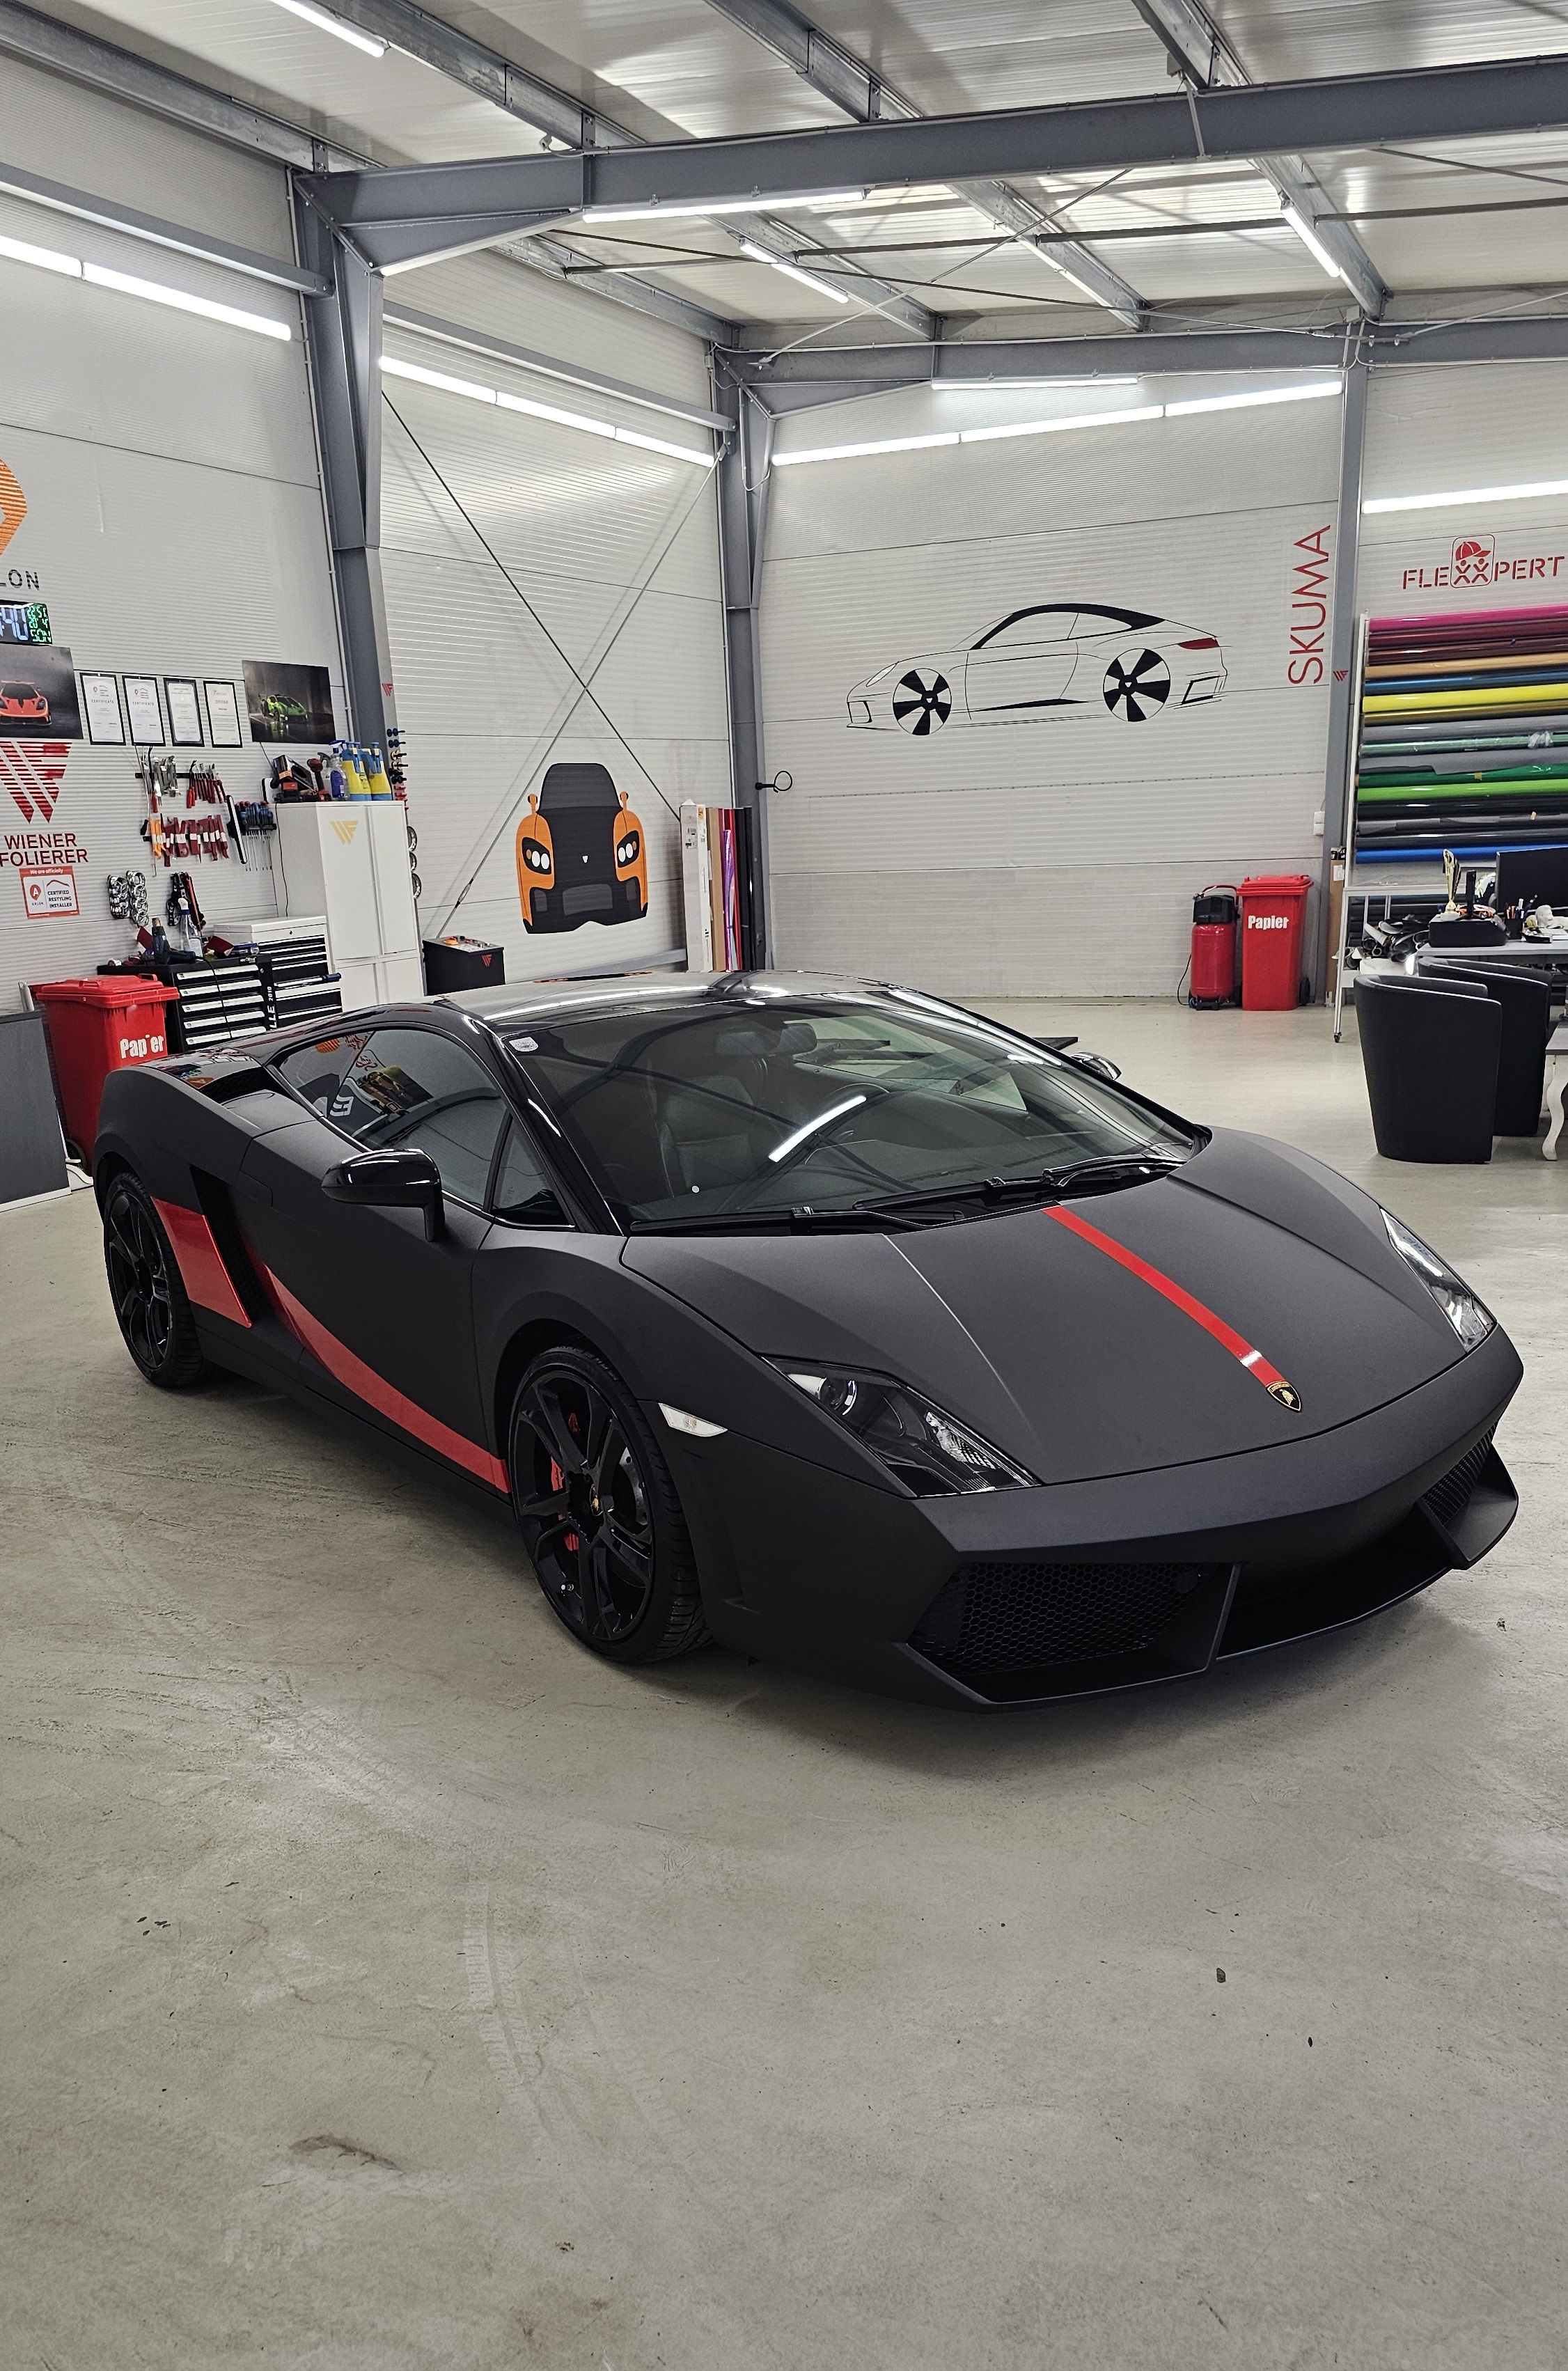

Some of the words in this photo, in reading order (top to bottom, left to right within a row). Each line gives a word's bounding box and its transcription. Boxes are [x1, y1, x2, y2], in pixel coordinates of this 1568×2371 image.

[1403, 556, 1565, 589] FLEXXPERT
[1288, 525, 1331, 684] SKUMA
[4, 834, 77, 850] WIENER
[0, 849, 88, 867] FOLIERER
[1248, 915, 1289, 930] Papier
